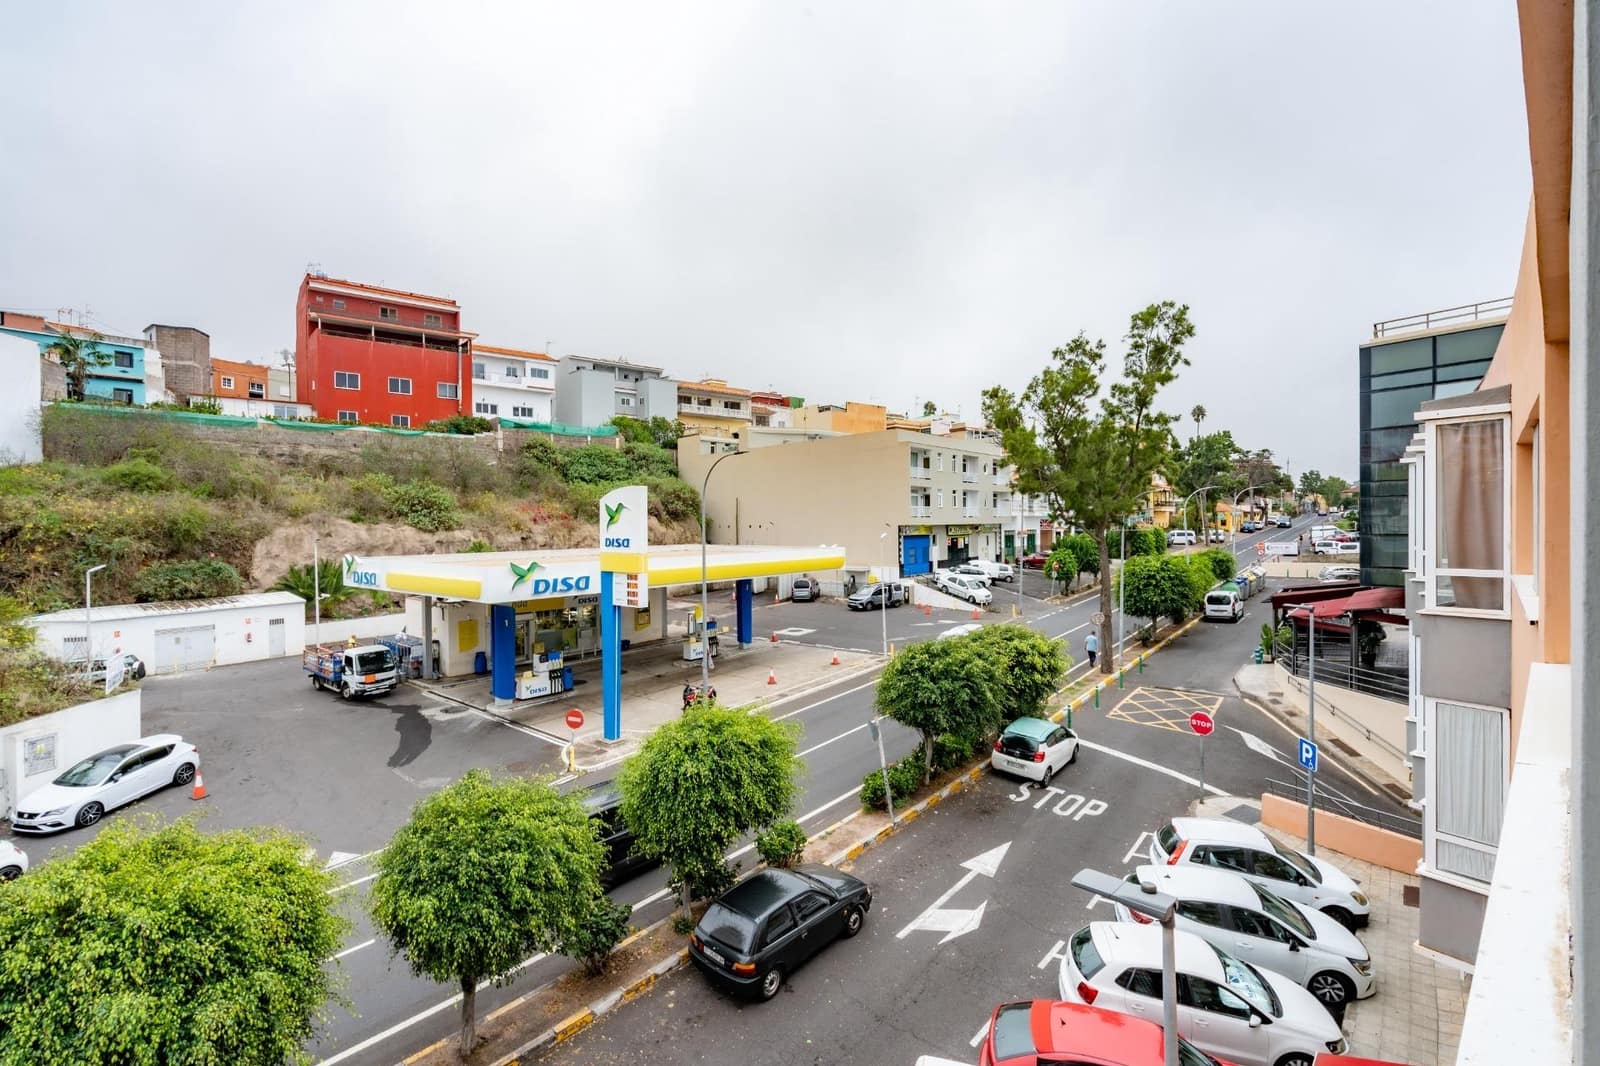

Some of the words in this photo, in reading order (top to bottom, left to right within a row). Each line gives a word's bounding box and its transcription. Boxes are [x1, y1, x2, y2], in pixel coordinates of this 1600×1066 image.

[1191, 718, 1212, 729] STOP
[1301, 742, 1313, 763] P
[1008, 782, 1109, 822] STOP
